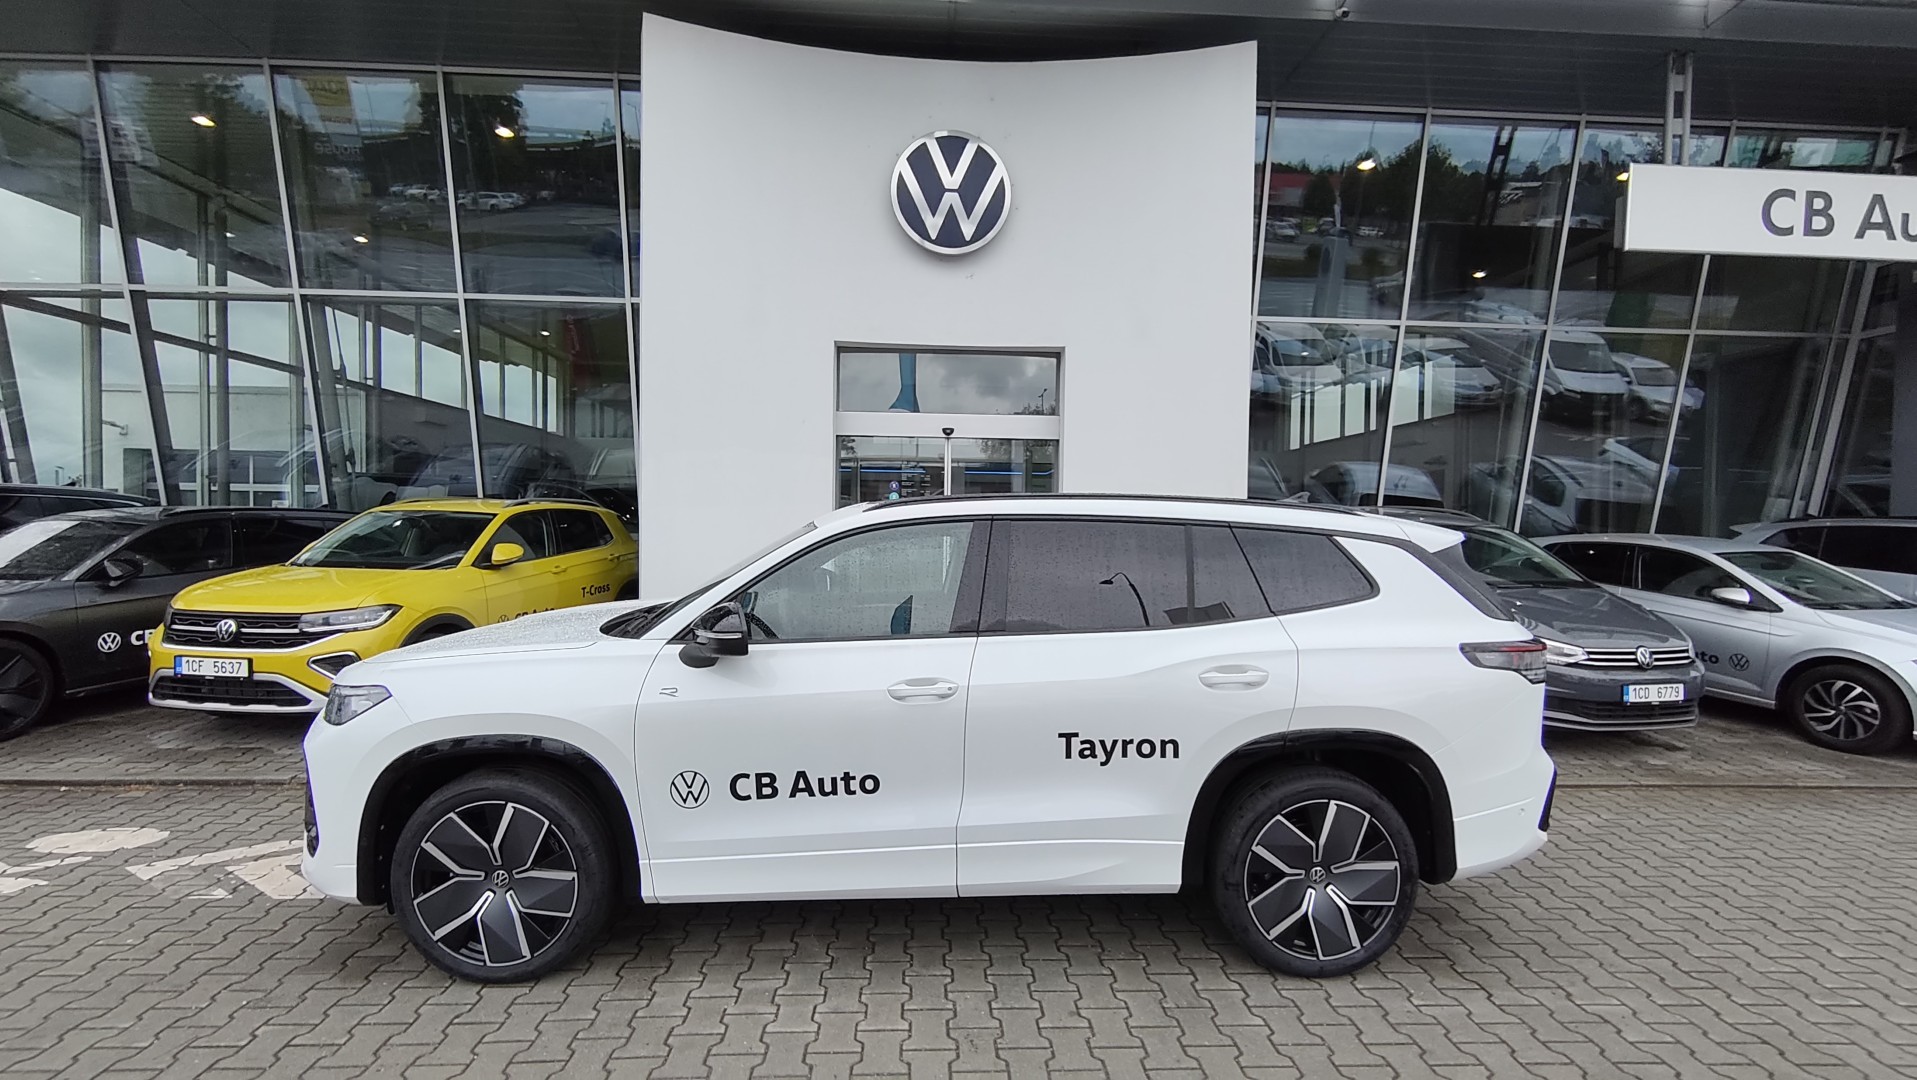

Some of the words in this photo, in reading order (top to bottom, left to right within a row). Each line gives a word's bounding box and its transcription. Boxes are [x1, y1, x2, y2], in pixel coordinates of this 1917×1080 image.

[1761, 188, 1835, 237] CB
[581, 583, 611, 598] T-Cross
[185, 659, 204, 673] 1CF
[213, 660, 242, 674] 5637
[1632, 685, 1650, 699] 1CD
[1657, 685, 1680, 699] 6779
[1057, 732, 1180, 767] Tayron
[729, 772, 779, 801] CB
[788, 770, 881, 799] Auto
